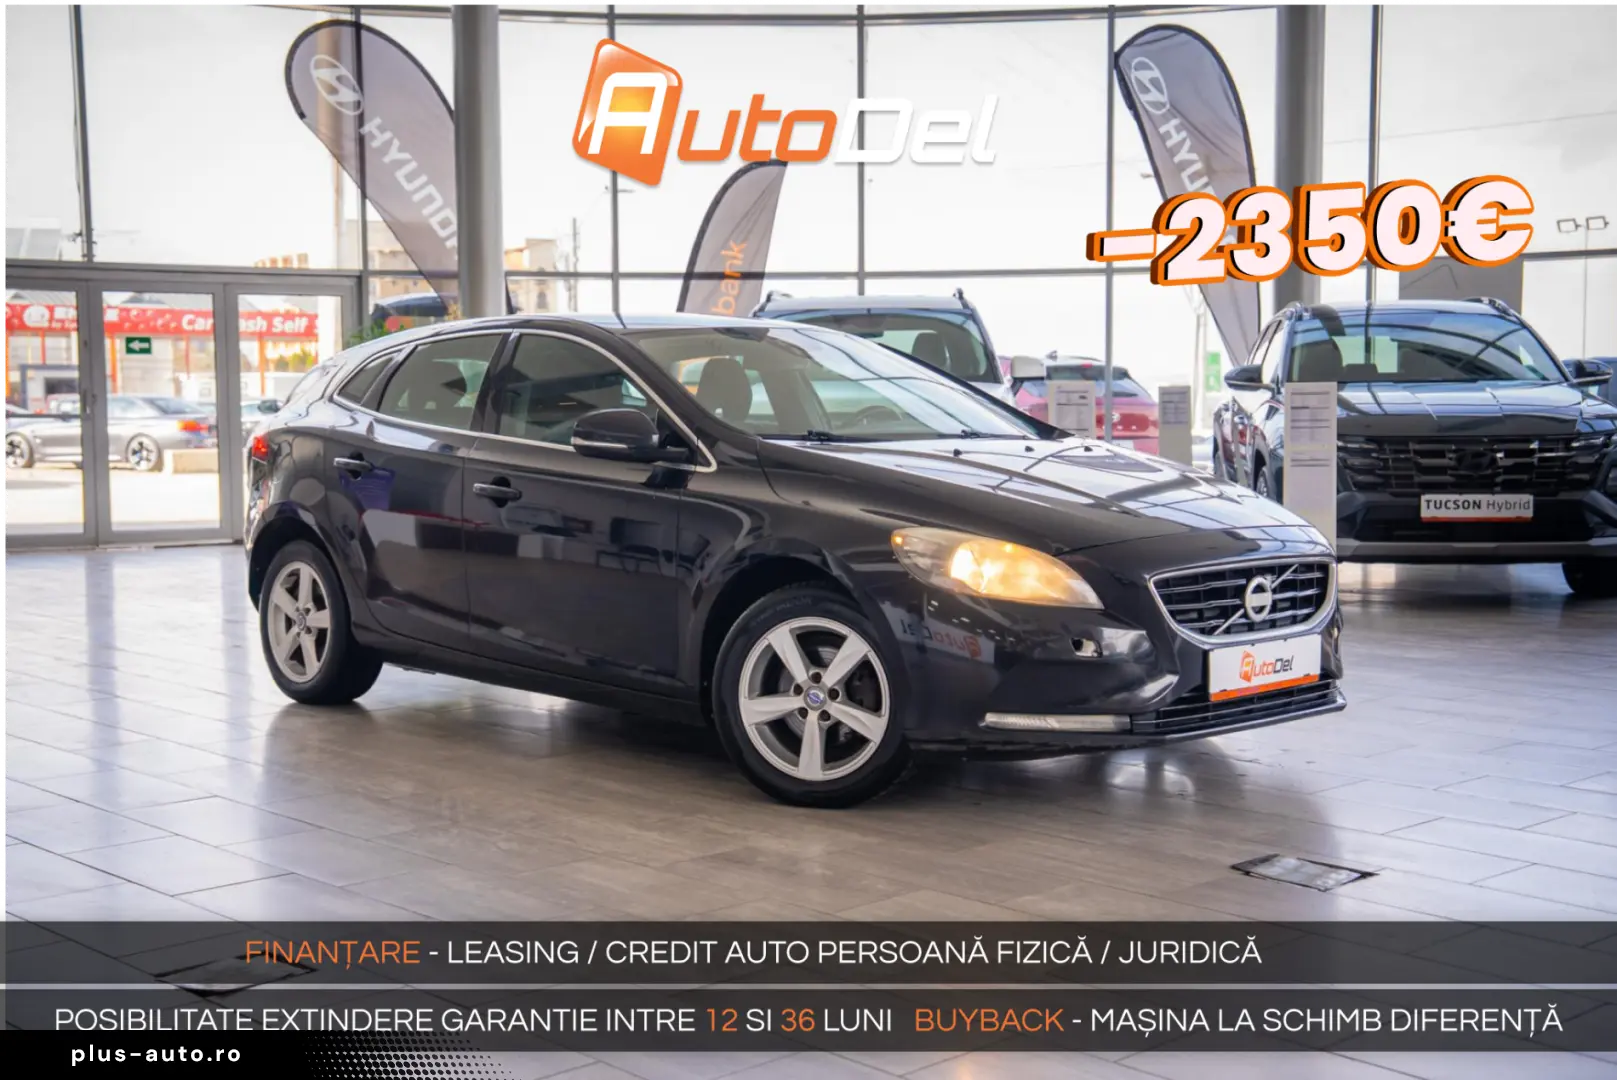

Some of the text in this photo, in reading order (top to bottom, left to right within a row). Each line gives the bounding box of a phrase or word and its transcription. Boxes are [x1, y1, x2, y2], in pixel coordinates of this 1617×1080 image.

[1158, 117, 1218, 194] HYU
[710, 240, 748, 316] bank
[272, 315, 309, 334] Self
[1424, 499, 1531, 512] TUCSON Hybrid
[1240, 653, 1295, 681] AutoDel
